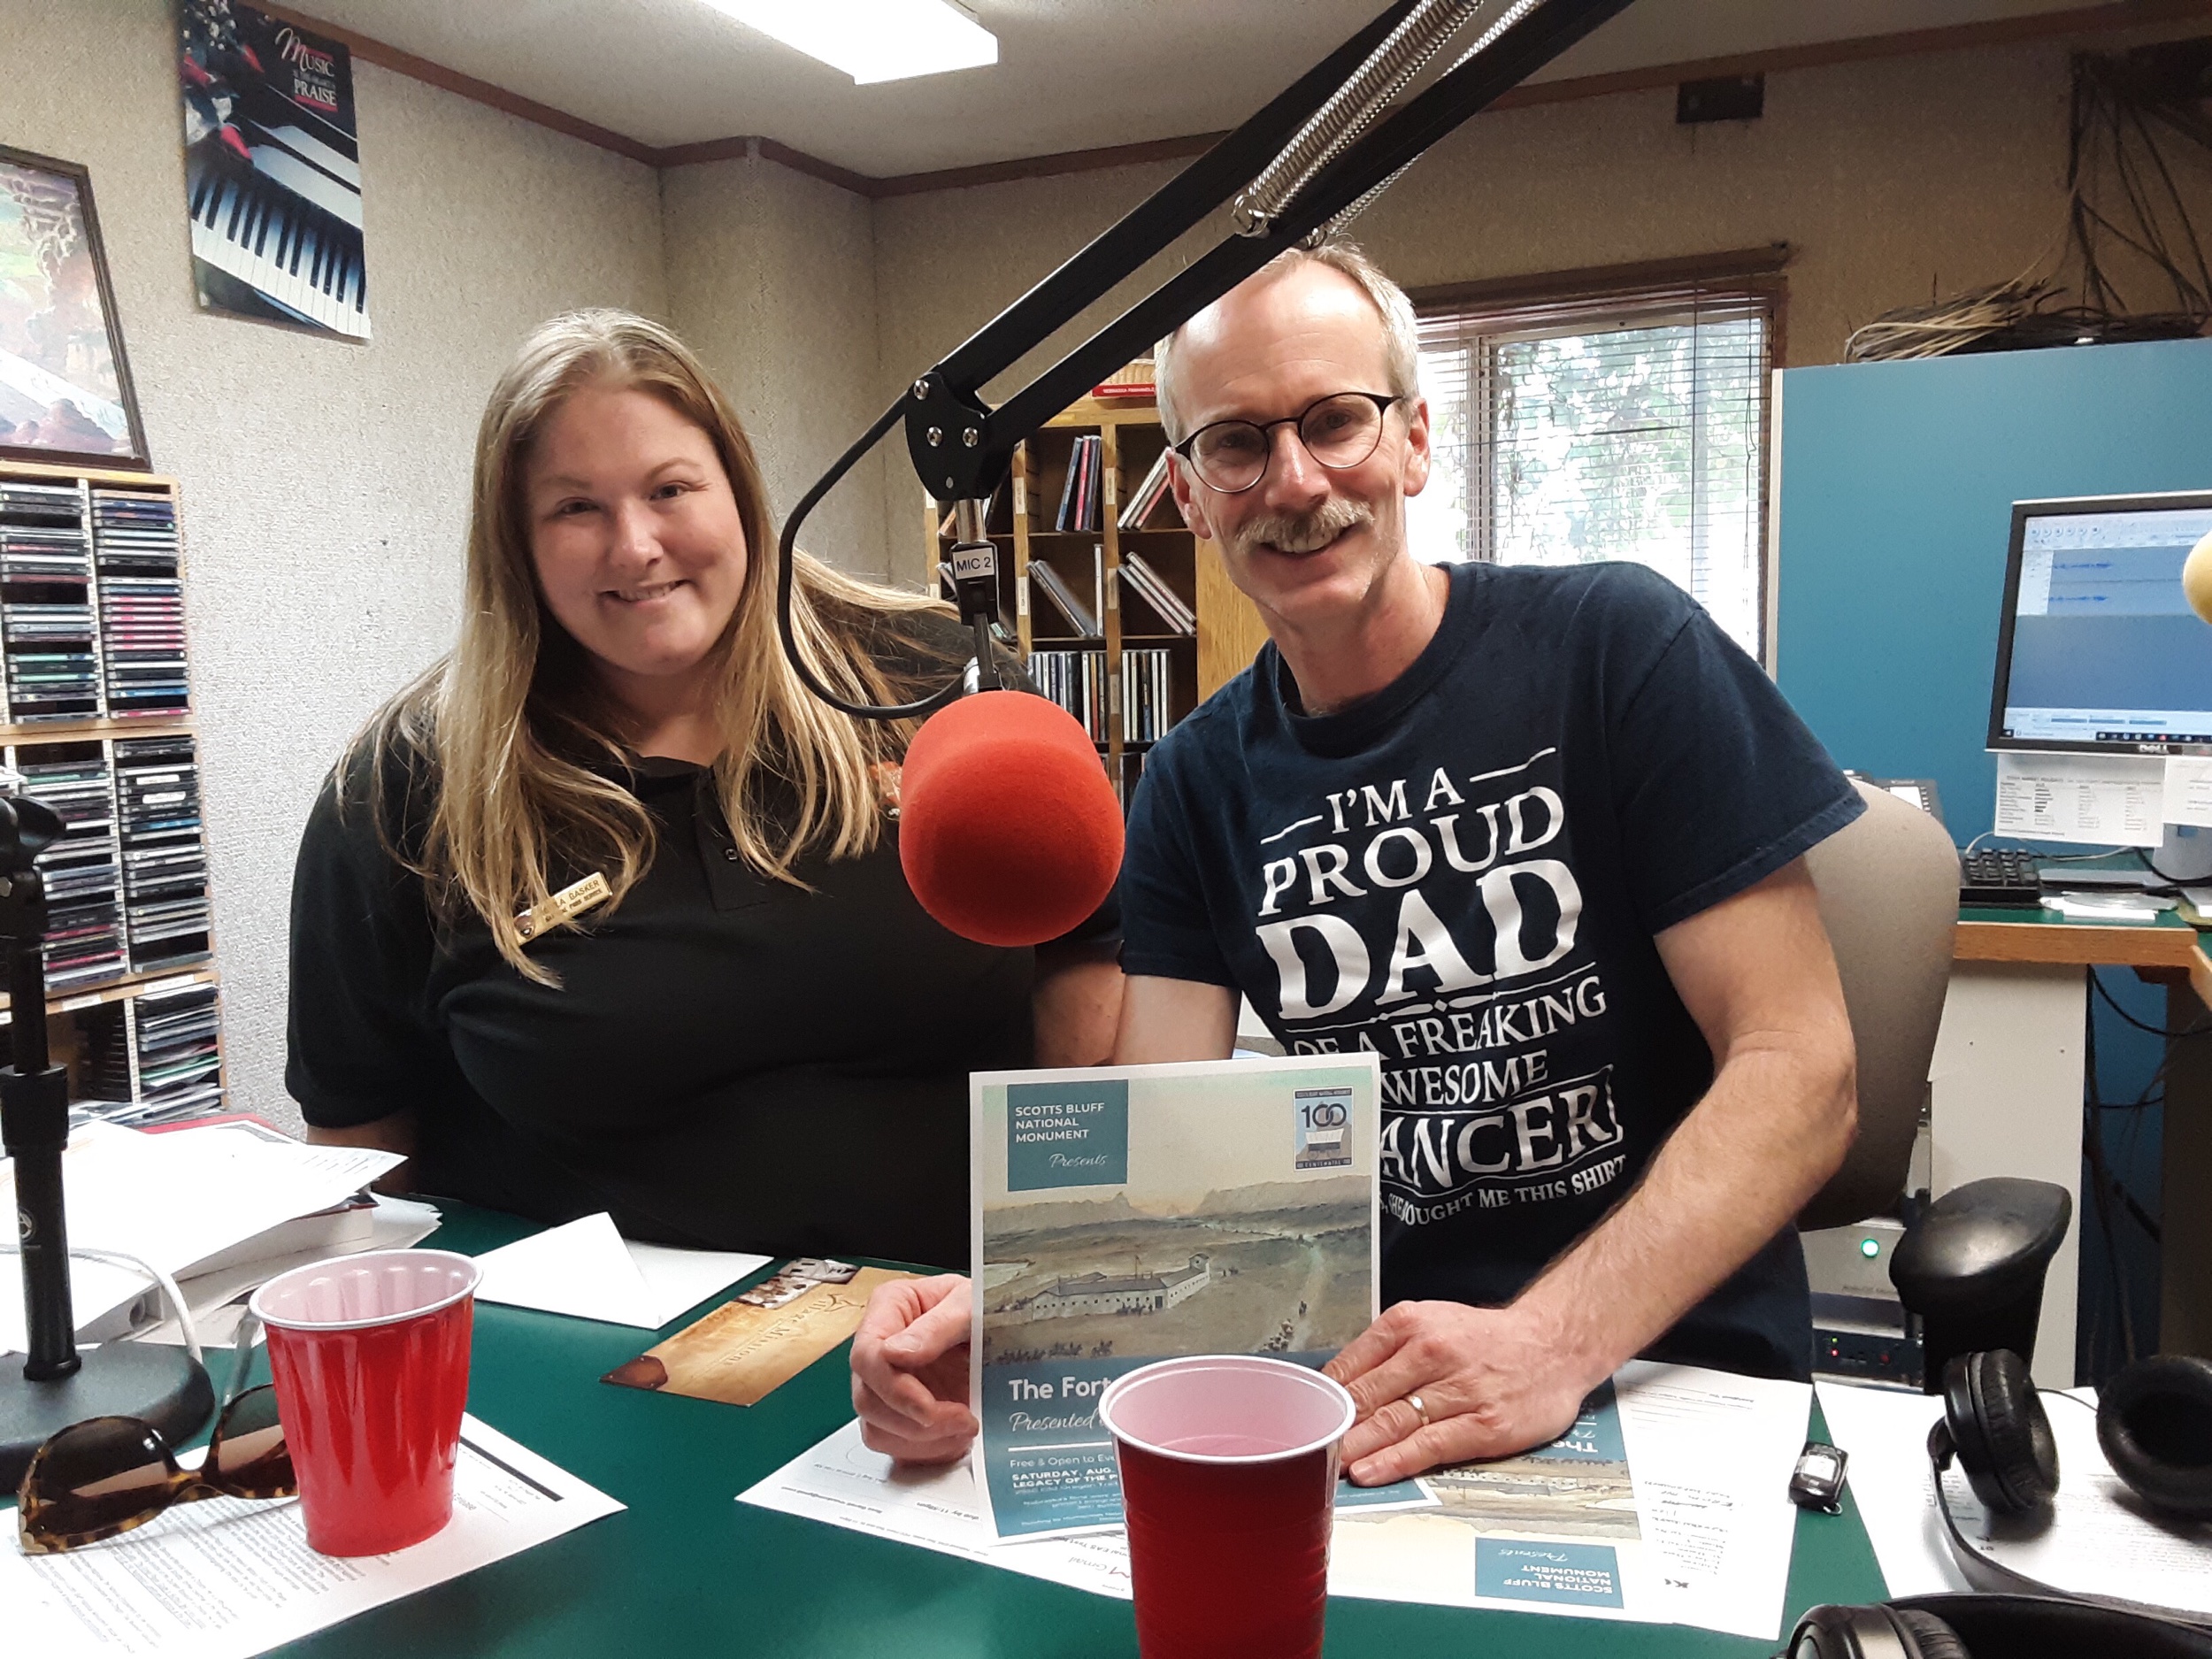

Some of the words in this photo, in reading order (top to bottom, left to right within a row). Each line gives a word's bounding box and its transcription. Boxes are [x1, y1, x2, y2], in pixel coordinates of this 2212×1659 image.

[294, 78, 337, 105] PRAISE
[956, 557, 980, 572] MIC
[984, 557, 991, 567] 2
[1325, 780, 1413, 834] I'M
[1424, 767, 1465, 811] A
[1257, 786, 1563, 917] PROUD
[568, 880, 600, 900] GASKER
[1256, 859, 1582, 1019] DAD
[1391, 976, 1607, 1060] FREAKING
[1381, 1049, 1548, 1106] WESOME
[1015, 1104, 1063, 1117] SCOTTS
[1066, 1102, 1105, 1113] BLUFF
[1301, 1102, 1347, 1128] 100
[1016, 1118, 1079, 1130] NATIONAL
[1016, 1129, 1089, 1143] MONUMENT
[1048, 1153, 1108, 1168] Presents
[1478, 1188, 1510, 1208] ME
[1514, 1180, 1567, 1202] THIS
[1571, 1154, 1626, 1195] SHIRT
[1009, 1379, 1054, 1401] The
[1009, 1407, 1099, 1432] Presented
[1048, 1456, 1080, 1466] Open
[1011, 1469, 1082, 1481] SATURDAY,
[1012, 1479, 1061, 1488] LEGACY
[1497, 1548, 1568, 1562] Presents
[1068, 1557, 1107, 1571] Gmail
[1521, 1565, 1610, 1578] MONUMENT
[1503, 1578, 1551, 1588] BLUFF
[1534, 1573, 1611, 1585] NATIONAL
[1556, 1582, 1613, 1594] SCOTTS
